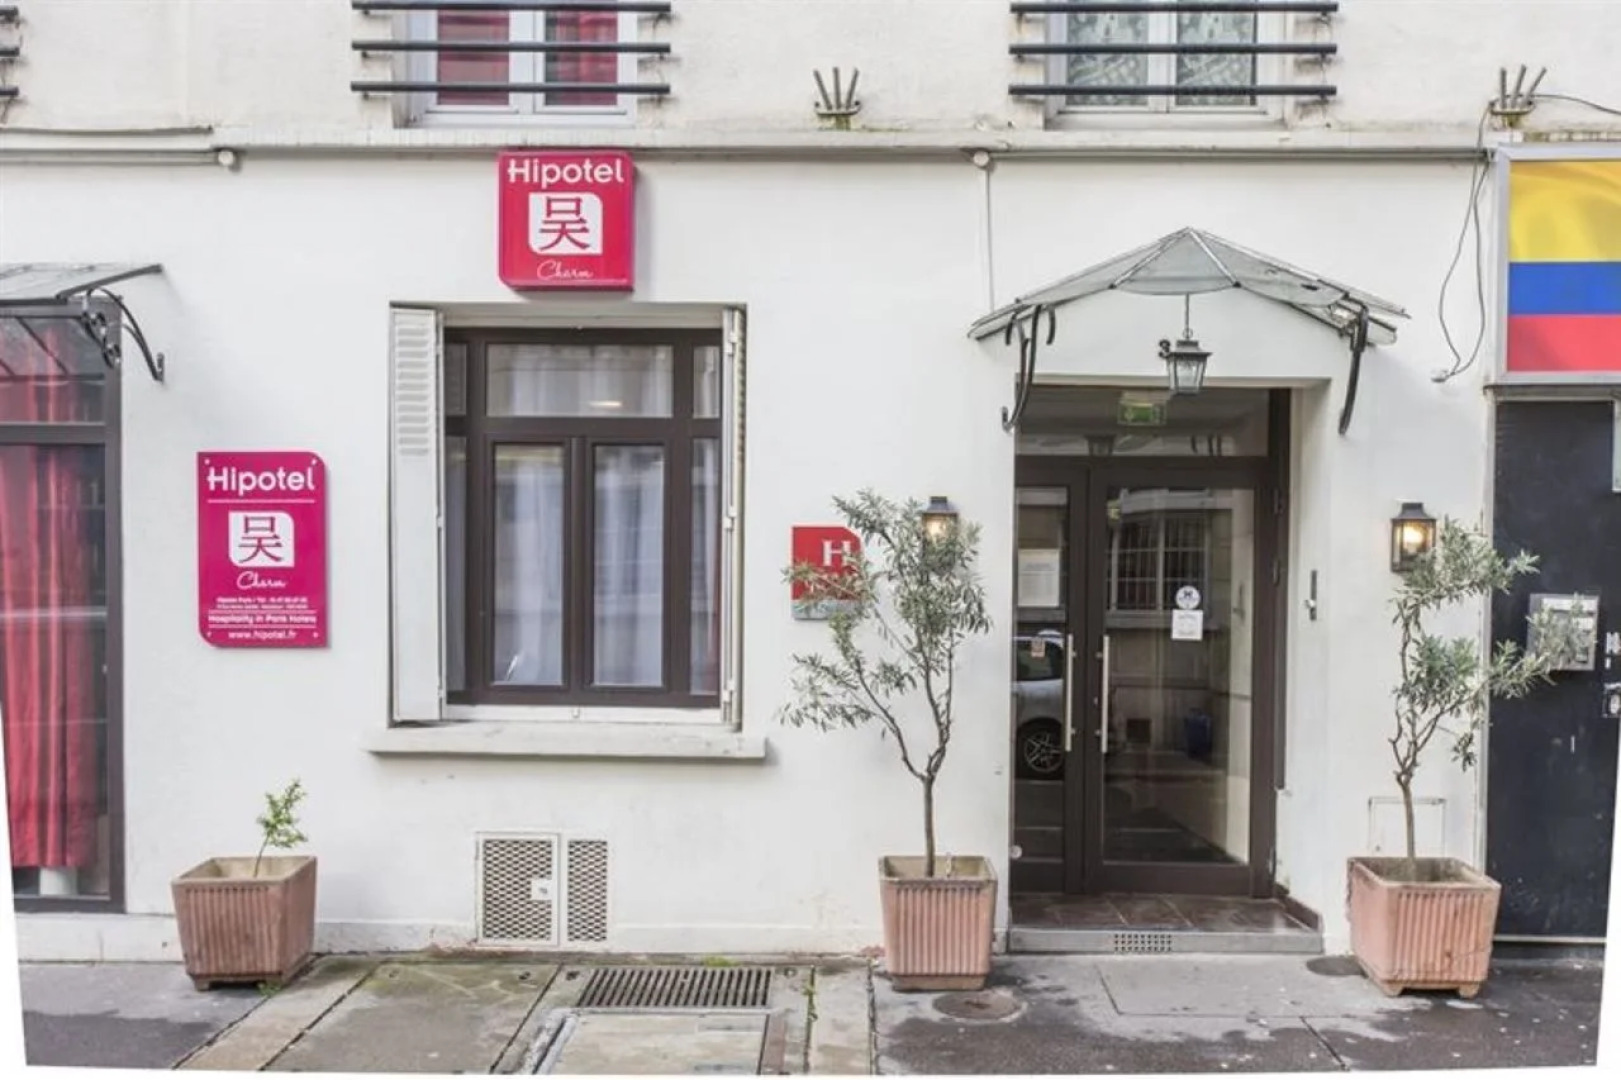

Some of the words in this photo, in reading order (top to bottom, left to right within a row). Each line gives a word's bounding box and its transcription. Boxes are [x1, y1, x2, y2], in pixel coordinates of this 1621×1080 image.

[507, 158, 624, 189] Hipotel
[536, 258, 594, 281] Charm
[207, 466, 315, 496] Hipotel
[822, 540, 851, 567] H
[228, 630, 297, 641] www.hipotel.fr
